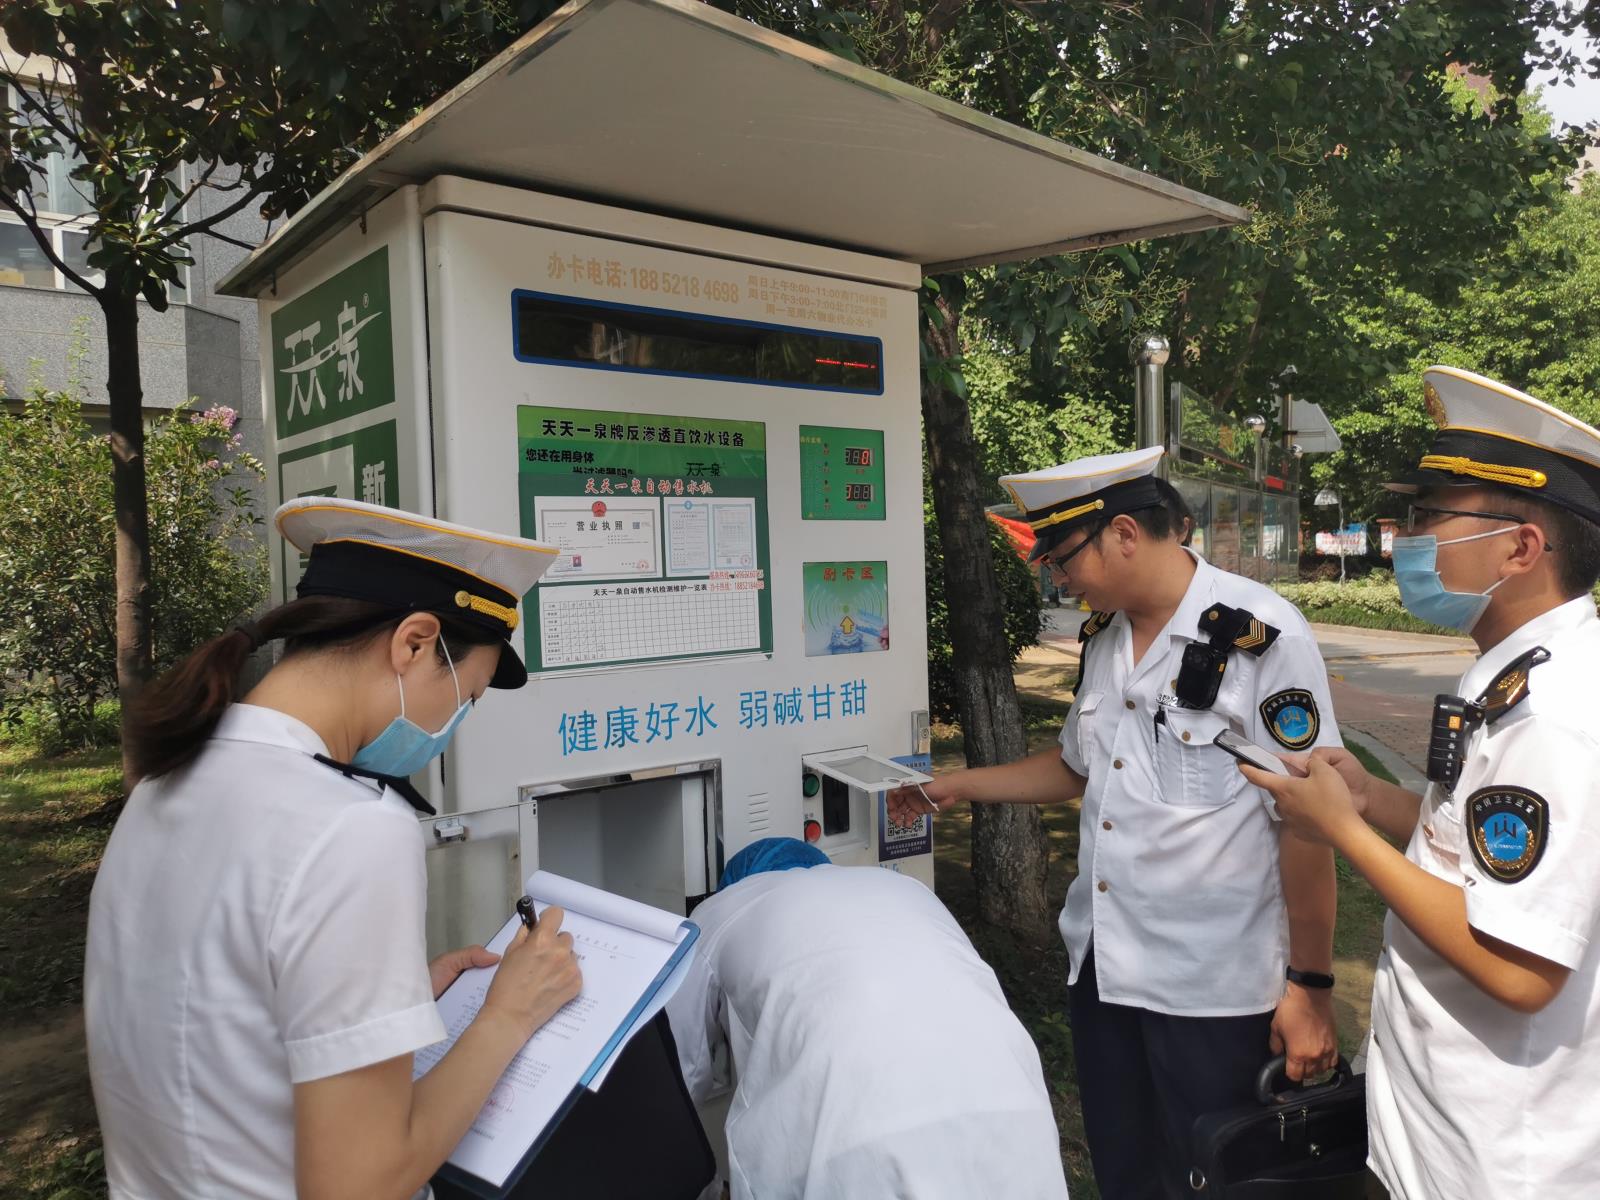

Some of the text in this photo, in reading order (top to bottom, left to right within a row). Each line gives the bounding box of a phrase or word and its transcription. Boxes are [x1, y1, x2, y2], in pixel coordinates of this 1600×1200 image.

[663, 273, 701, 298] 5218
[703, 281, 739, 304] 4698
[541, 418, 745, 448] 天天一泉牌反渗透直饮水设备
[525, 448, 595, 464] 您还在用身体
[584, 478, 713, 496] 天天一泉自动售水机
[576, 520, 624, 532] 营业执照
[823, 567, 874, 582] 刷卡区
[593, 583, 708, 597] 天天一泉自动售水机检测维护一览表
[558, 678, 868, 757] 健康好水 弱碱甘甜
